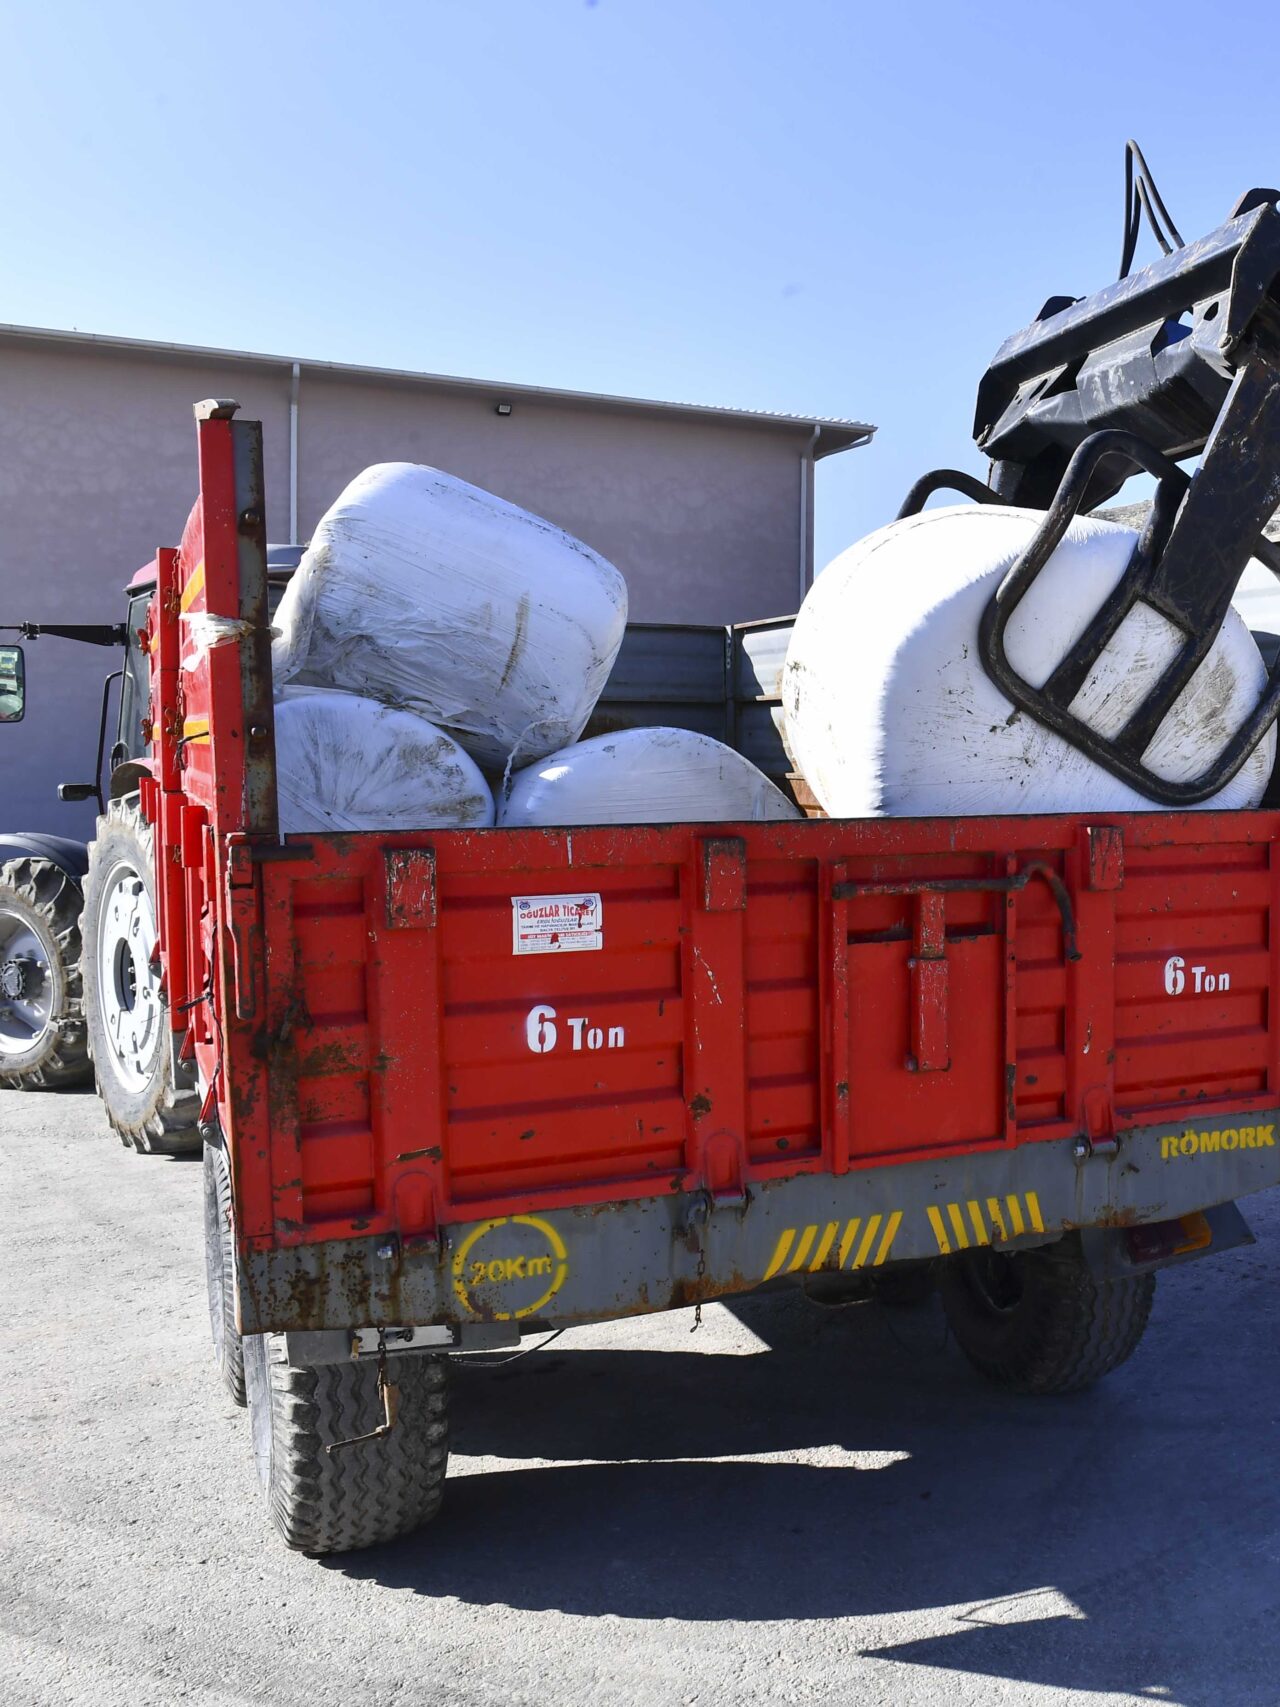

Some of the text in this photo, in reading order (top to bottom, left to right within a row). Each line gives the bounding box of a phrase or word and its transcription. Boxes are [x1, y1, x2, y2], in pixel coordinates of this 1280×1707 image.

[520, 904, 560, 920] OĞUZLAR
[1164, 956, 1230, 995] 6 Ton
[526, 1004, 625, 1053] 6 Ton
[1160, 1124, 1276, 1159] RÖMORK
